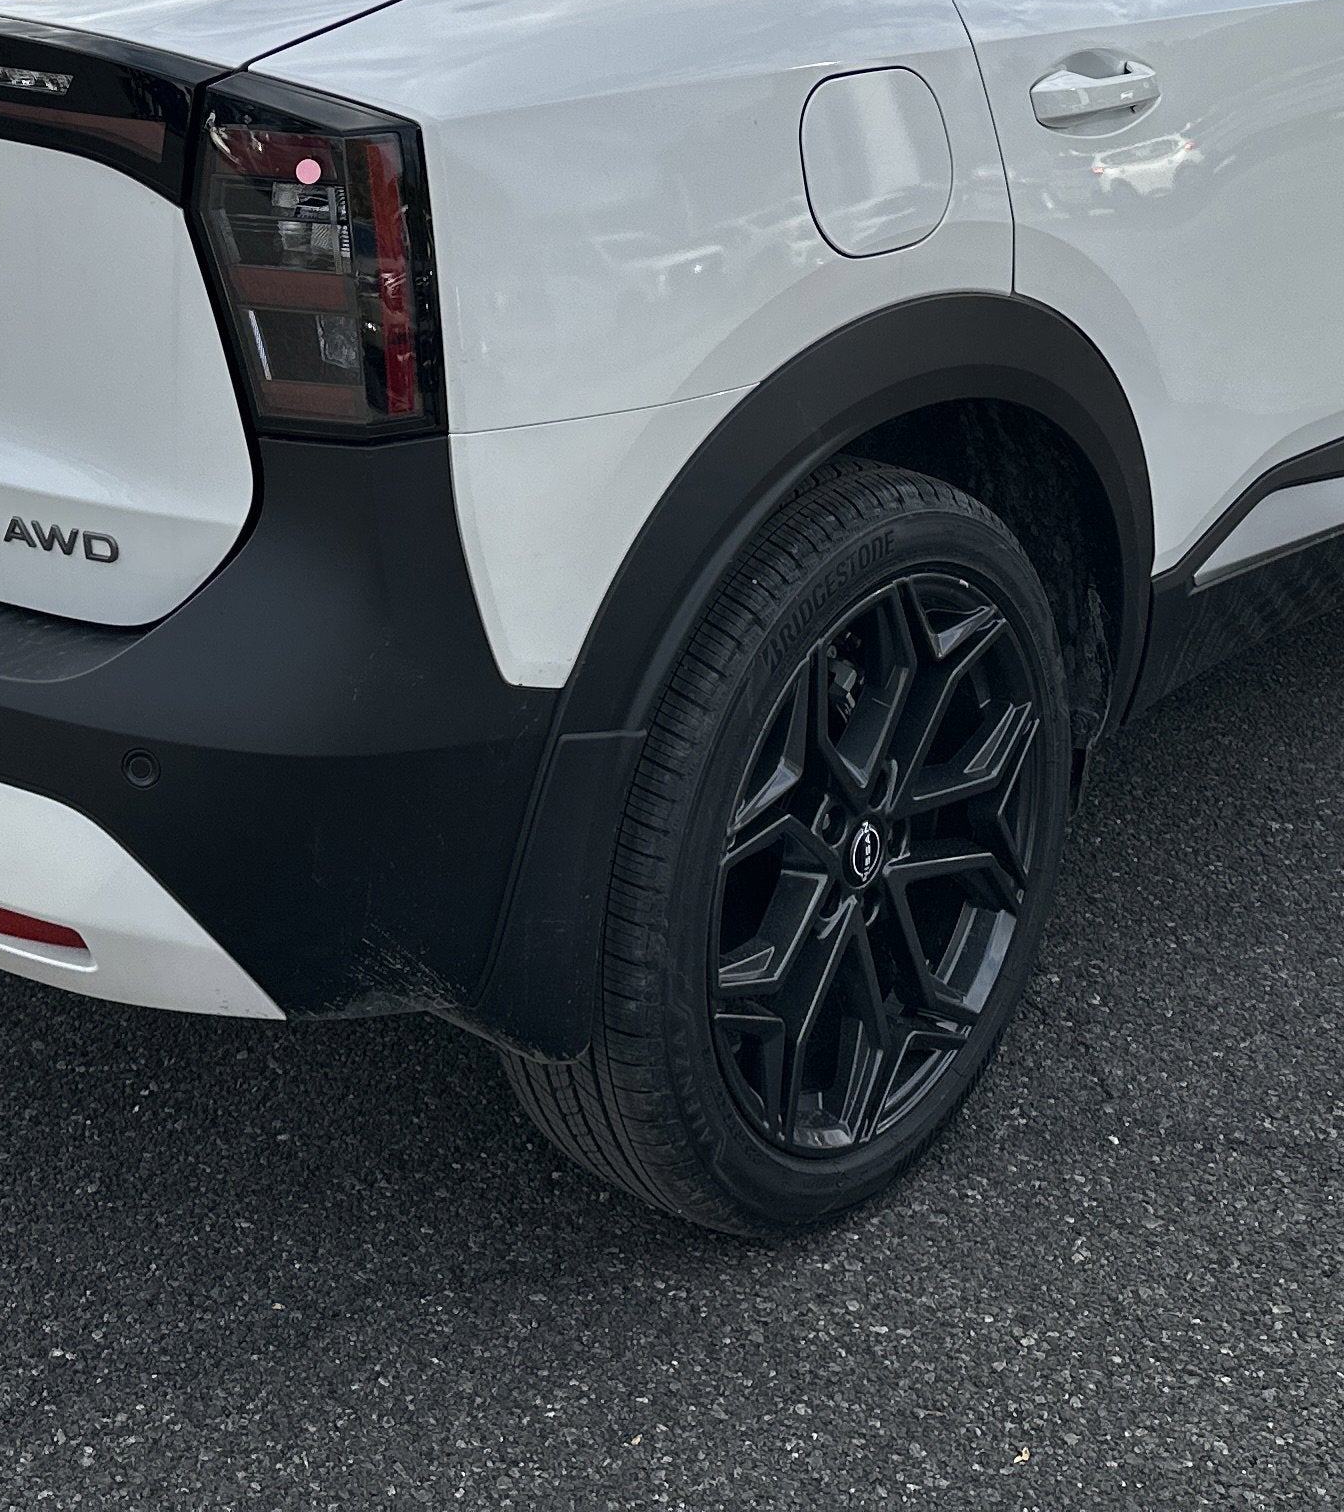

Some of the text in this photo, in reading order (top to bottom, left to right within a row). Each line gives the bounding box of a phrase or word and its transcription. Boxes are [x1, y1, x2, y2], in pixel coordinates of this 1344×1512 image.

[4, 516, 119, 563] AWD
[760, 530, 895, 675] BRIDGESTONE
[673, 1029, 713, 1143] ALENZA
